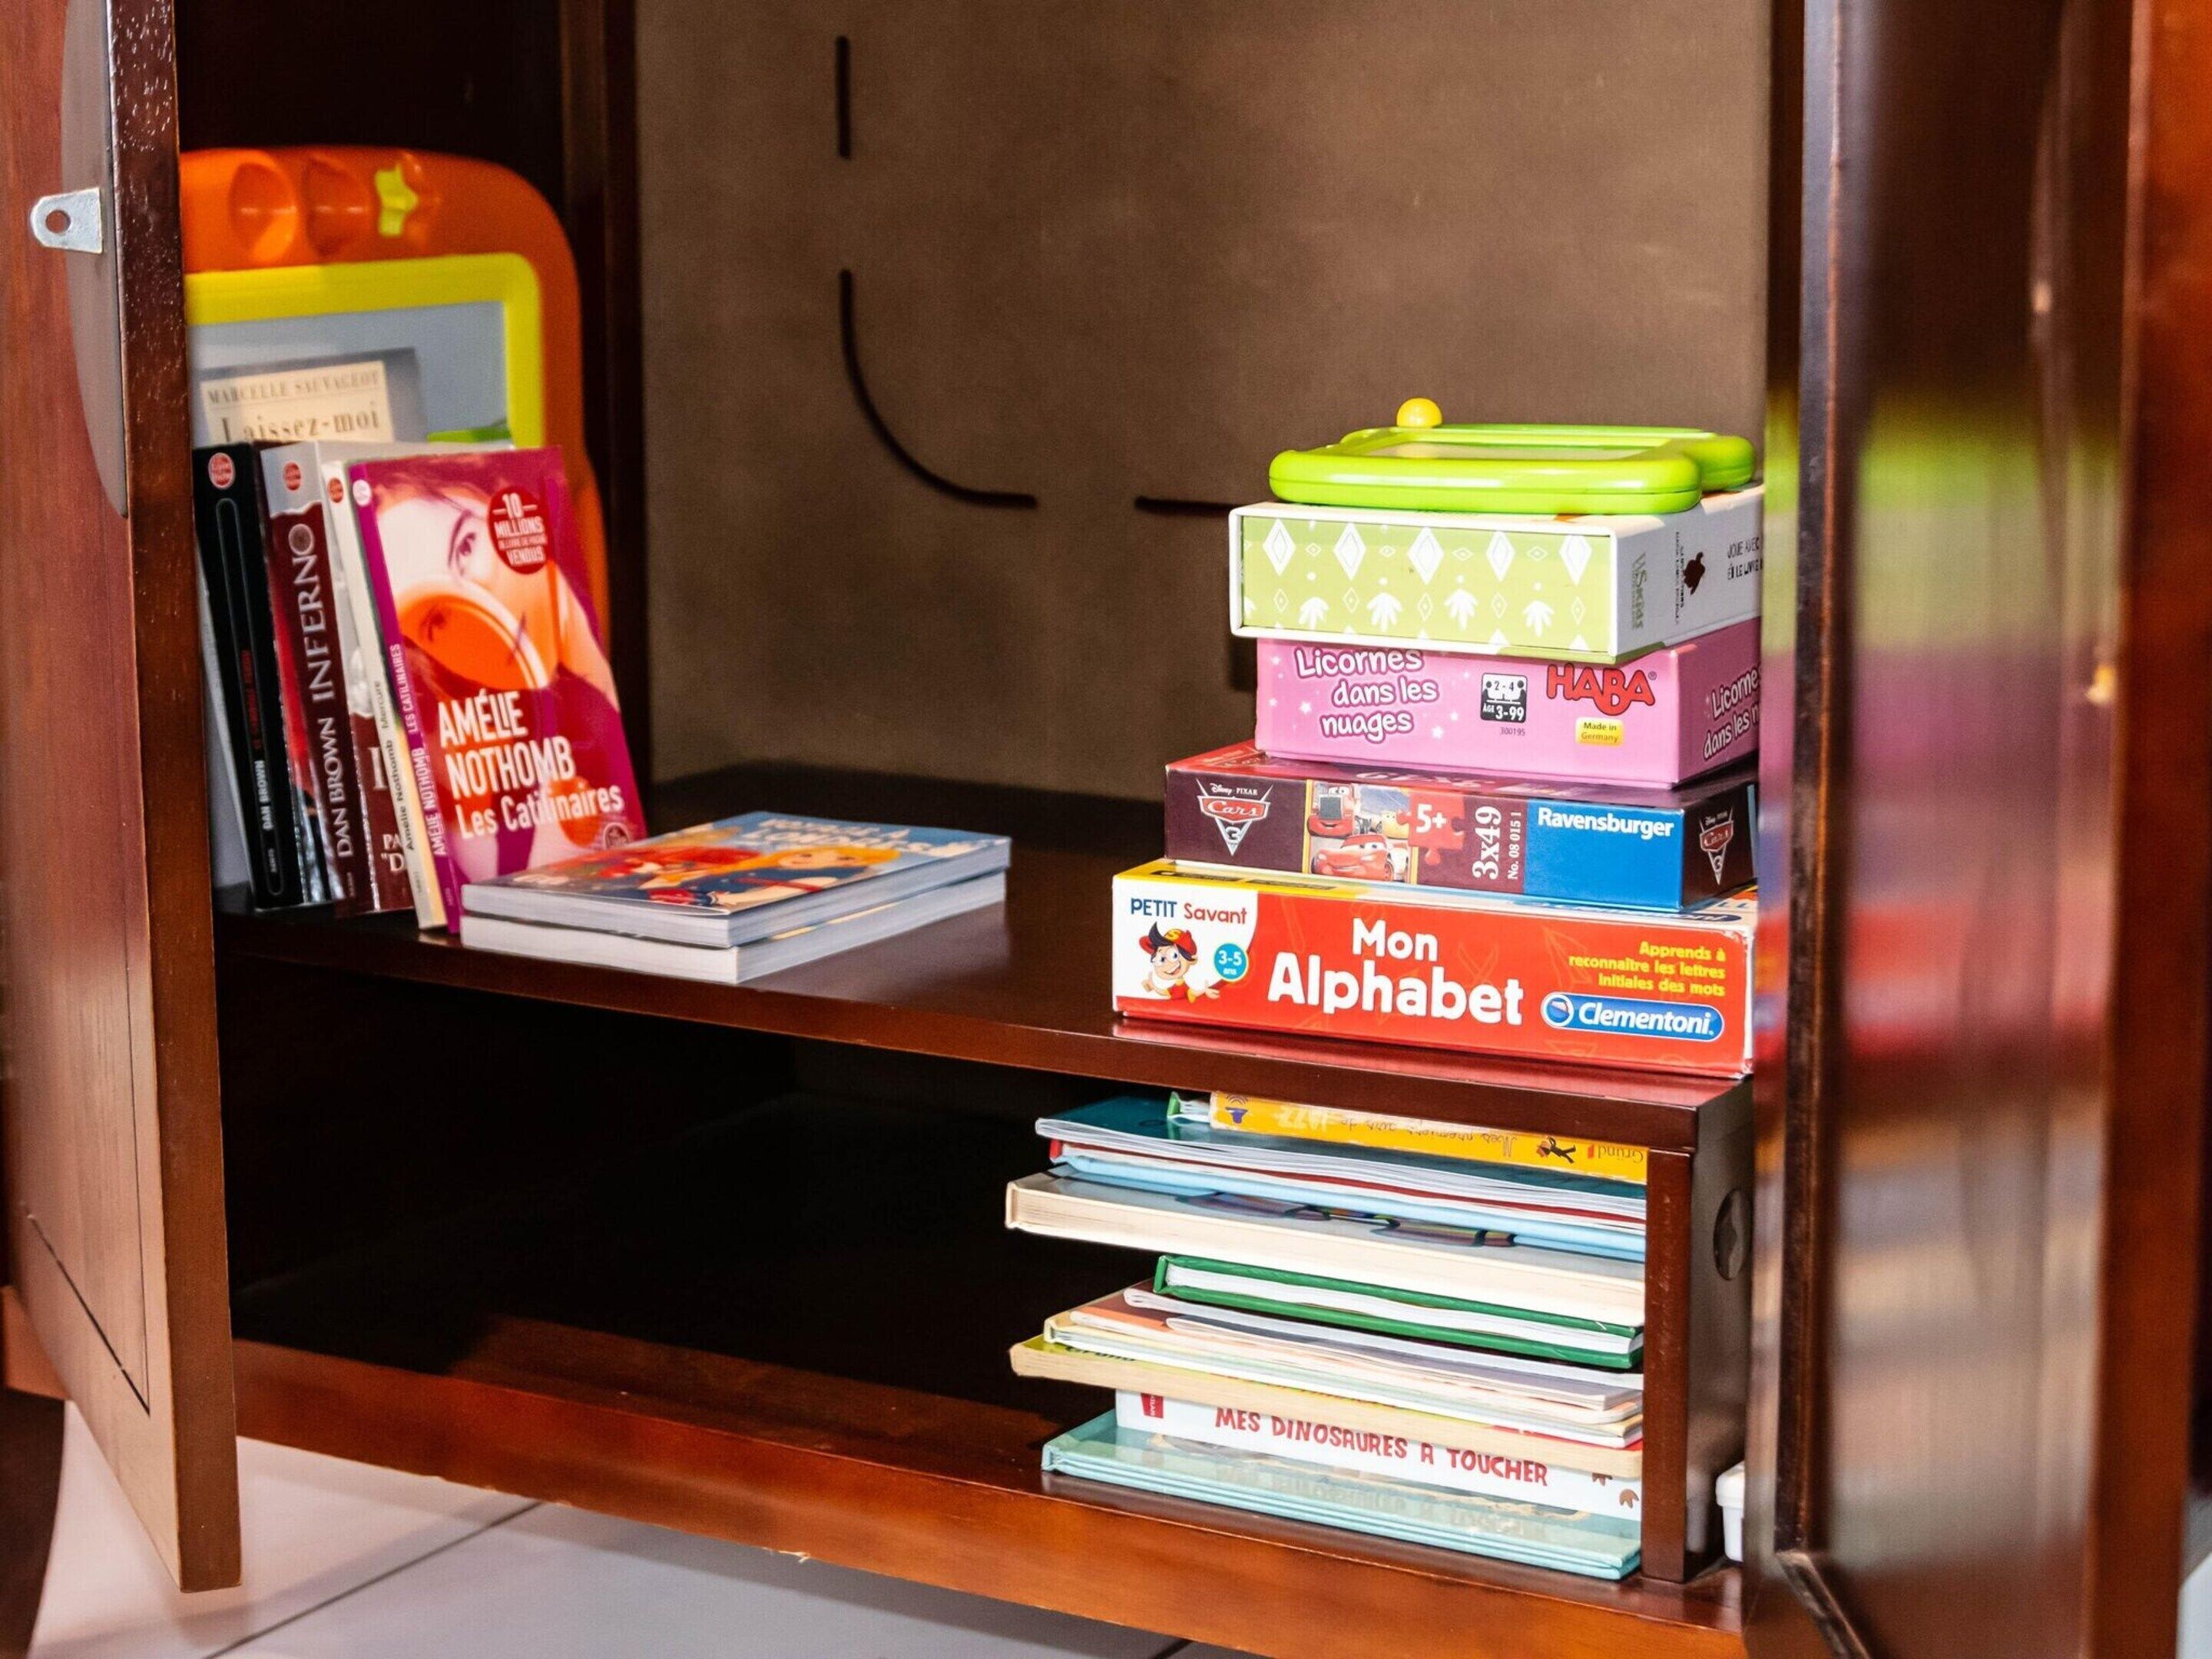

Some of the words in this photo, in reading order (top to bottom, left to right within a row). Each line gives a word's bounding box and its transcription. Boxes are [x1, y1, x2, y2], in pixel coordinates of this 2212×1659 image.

[207, 381, 287, 405] MARCELLE
[220, 399, 381, 443] Laissez-moi
[502, 492, 524, 519] 10
[288, 523, 336, 704] INFERNO
[1294, 647, 1424, 678] Licornes
[390, 643, 416, 714] CATILINAIRES
[1333, 679, 1396, 707] dans
[1398, 676, 1439, 703] les
[1546, 663, 1656, 716] HABA
[406, 714, 419, 734] LES
[438, 688, 528, 749] AMÉLIE
[1321, 710, 1414, 743] nuages
[1495, 704, 1525, 721] 3-99
[1584, 722, 1607, 731] Made
[1500, 727, 1526, 736] 300195
[1581, 733, 1619, 743] Germany
[1704, 724, 1732, 760] dans
[1734, 710, 1750, 739] les
[318, 717, 346, 803] BROWN
[386, 739, 403, 802] Nothomb
[445, 735, 575, 800] NOTHOMB
[253, 760, 270, 804] BROWN
[412, 747, 436, 810] NOTHOMB
[1236, 787, 1258, 796] PIXAR
[263, 805, 274, 831] DAN
[455, 803, 499, 839] Les
[500, 782, 625, 832] Catilinaires
[1207, 800, 1260, 816] Cars
[1416, 804, 1447, 833] 5+
[331, 806, 354, 858] DAN
[1224, 826, 1241, 841] 3
[1510, 821, 1522, 842] 015
[1537, 806, 1675, 840] Ravensburger
[1472, 806, 1502, 880] 3x49
[1508, 843, 1520, 857] 08
[1508, 860, 1519, 881] No.
[1131, 898, 1177, 918] PETIT
[1184, 902, 1247, 925] Savant
[1352, 917, 1438, 962] Mon
[1639, 941, 1711, 961] Apprends
[1716, 947, 1726, 962] à
[1218, 949, 1243, 966] 3-5
[1223, 968, 1237, 976] ans
[1568, 955, 1650, 973] reconnaître
[1654, 960, 1675, 975] les
[1680, 962, 1726, 979] lettres
[1267, 952, 1524, 1026] Alphabet
[1658, 979, 1685, 993] des
[1690, 982, 1726, 997] mots
[1598, 1145, 1644, 1164] Gründ
[1215, 1406, 1261, 1433] MES
[1271, 1416, 1409, 1460] DINOSAURES
[1445, 1447, 1548, 1488] TOUCHER
